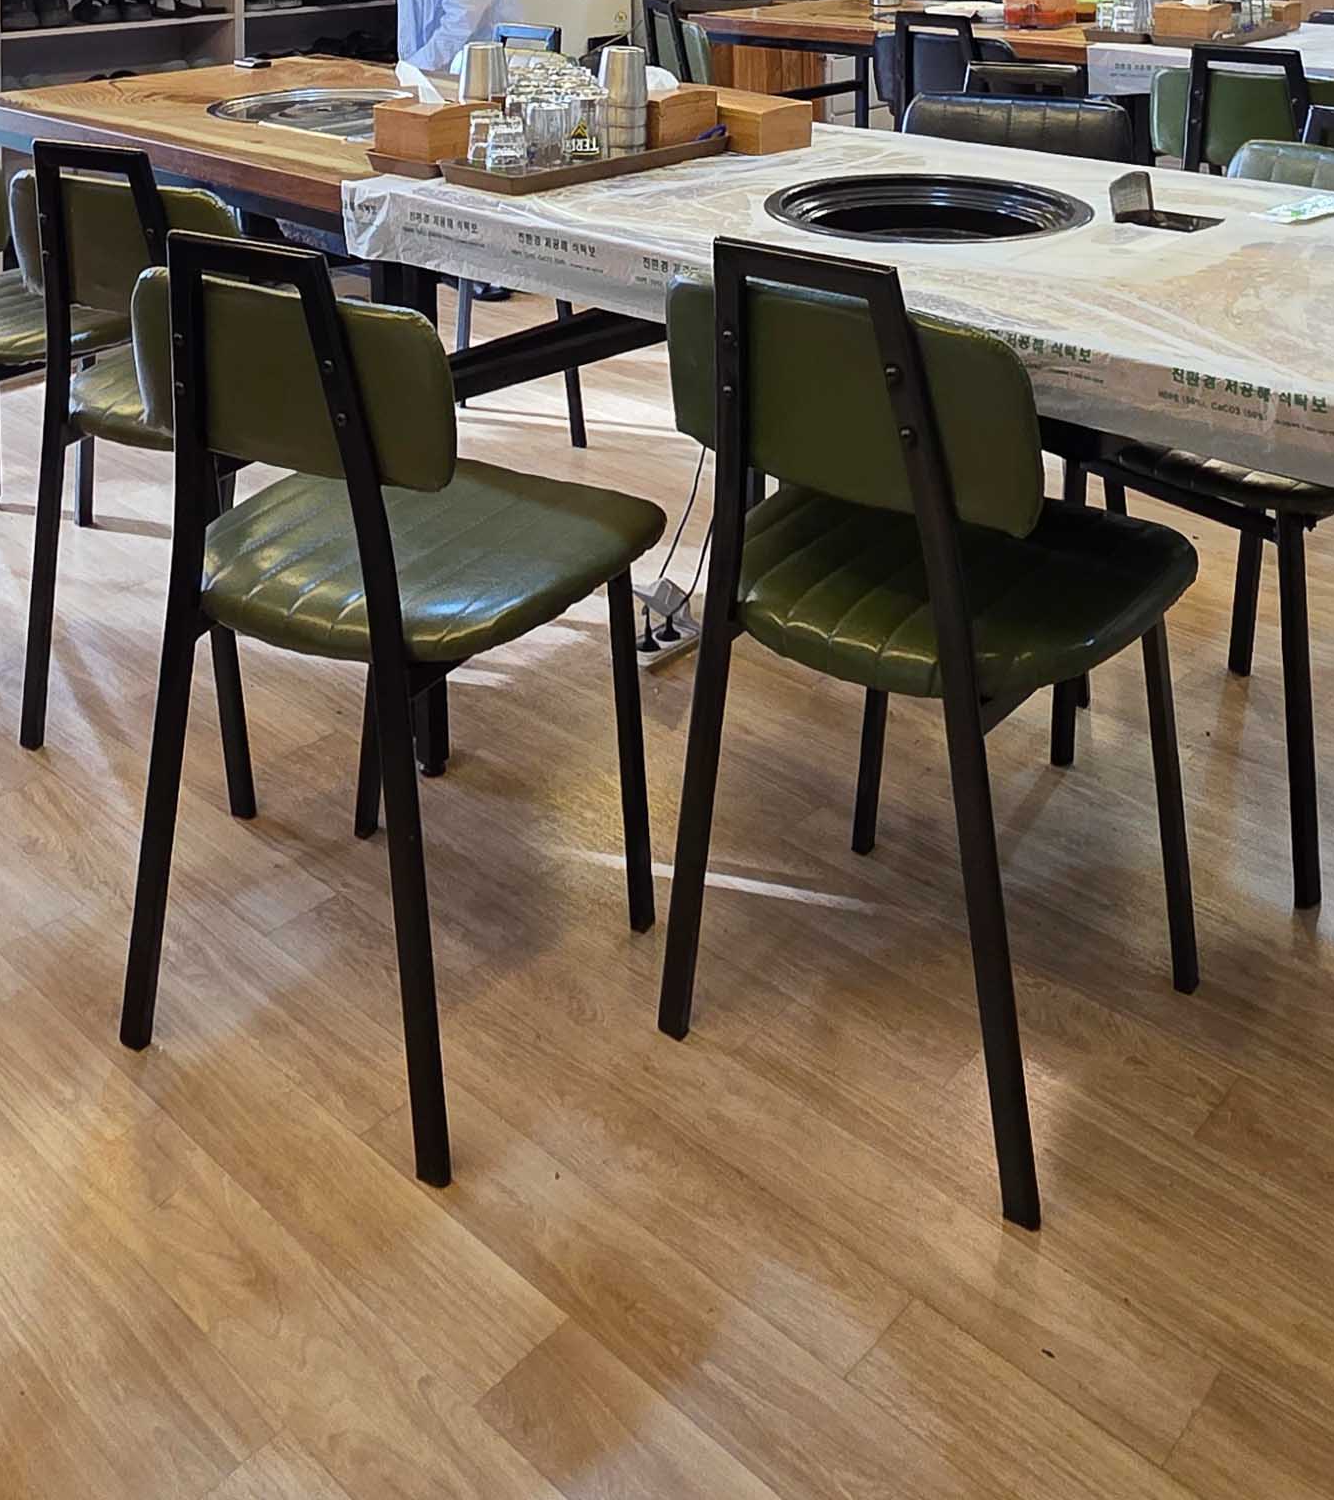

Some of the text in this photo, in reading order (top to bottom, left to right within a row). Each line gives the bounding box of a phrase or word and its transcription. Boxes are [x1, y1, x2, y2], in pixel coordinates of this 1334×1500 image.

[1171, 366, 1328, 415] 친환경 저공해 식탁보
